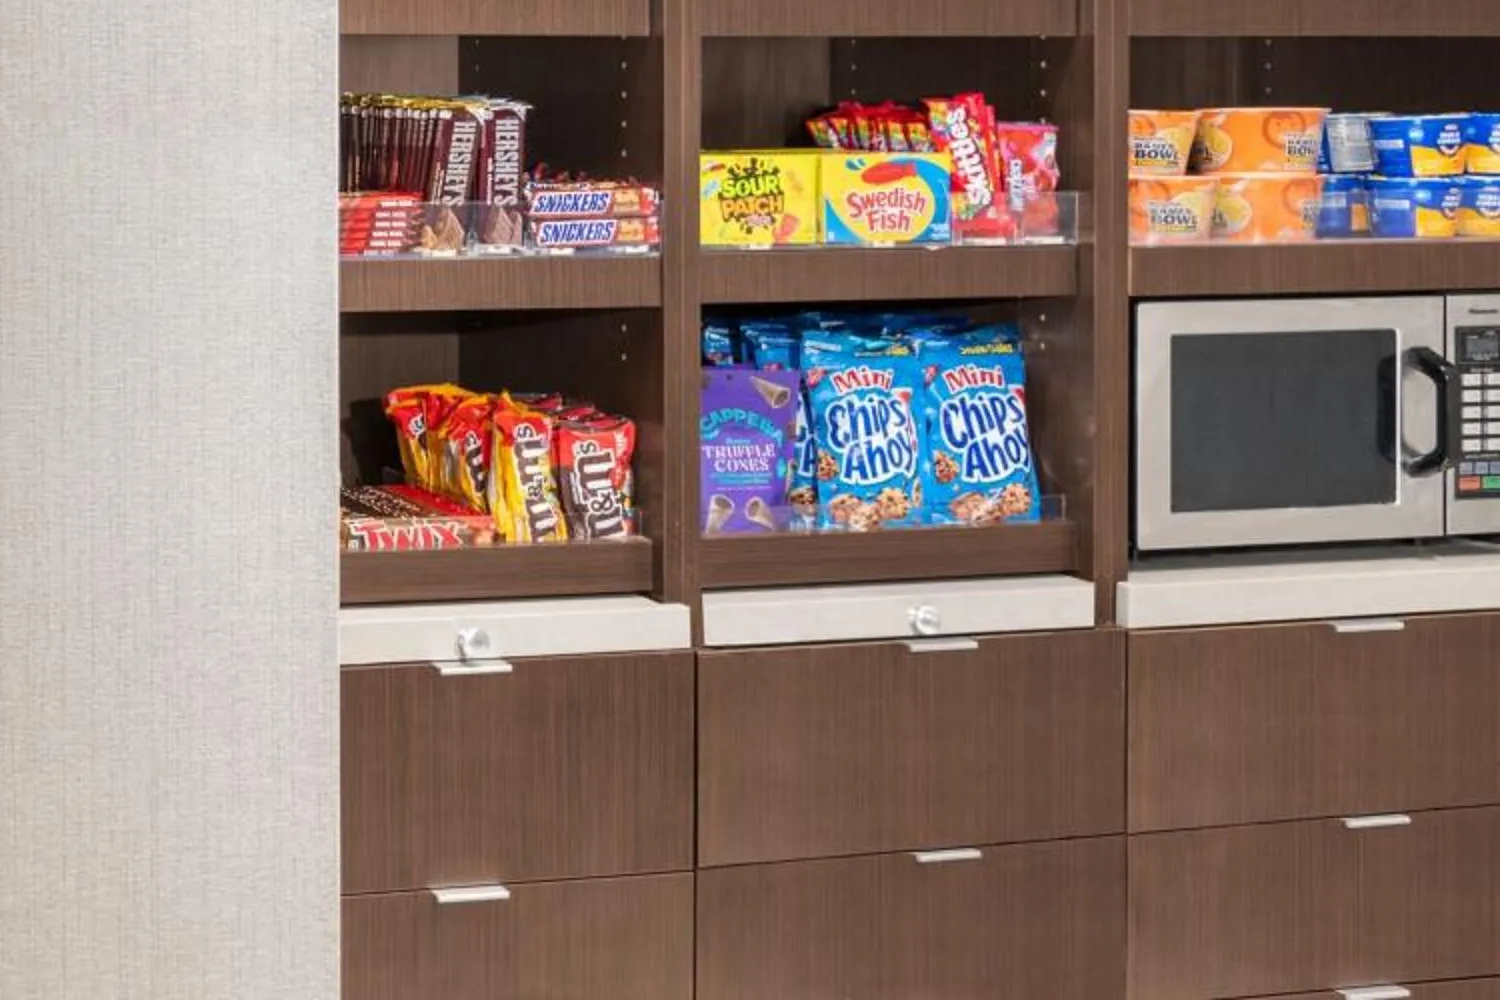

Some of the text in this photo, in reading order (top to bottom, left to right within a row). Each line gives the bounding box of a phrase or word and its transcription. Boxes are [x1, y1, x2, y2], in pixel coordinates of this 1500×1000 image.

[722, 175, 781, 197] SOUR
[534, 192, 609, 213] SNICKERS
[721, 195, 784, 219] PATCH
[845, 187, 927, 218] Swedish
[542, 222, 614, 242] SNICKERS
[866, 209, 911, 231] Fish
[831, 366, 893, 394] Mini
[943, 364, 1004, 392] Mini
[828, 395, 906, 449] Chips
[942, 393, 1024, 449] Chips
[713, 458, 769, 472] CONES
[843, 434, 914, 480] Ahoy
